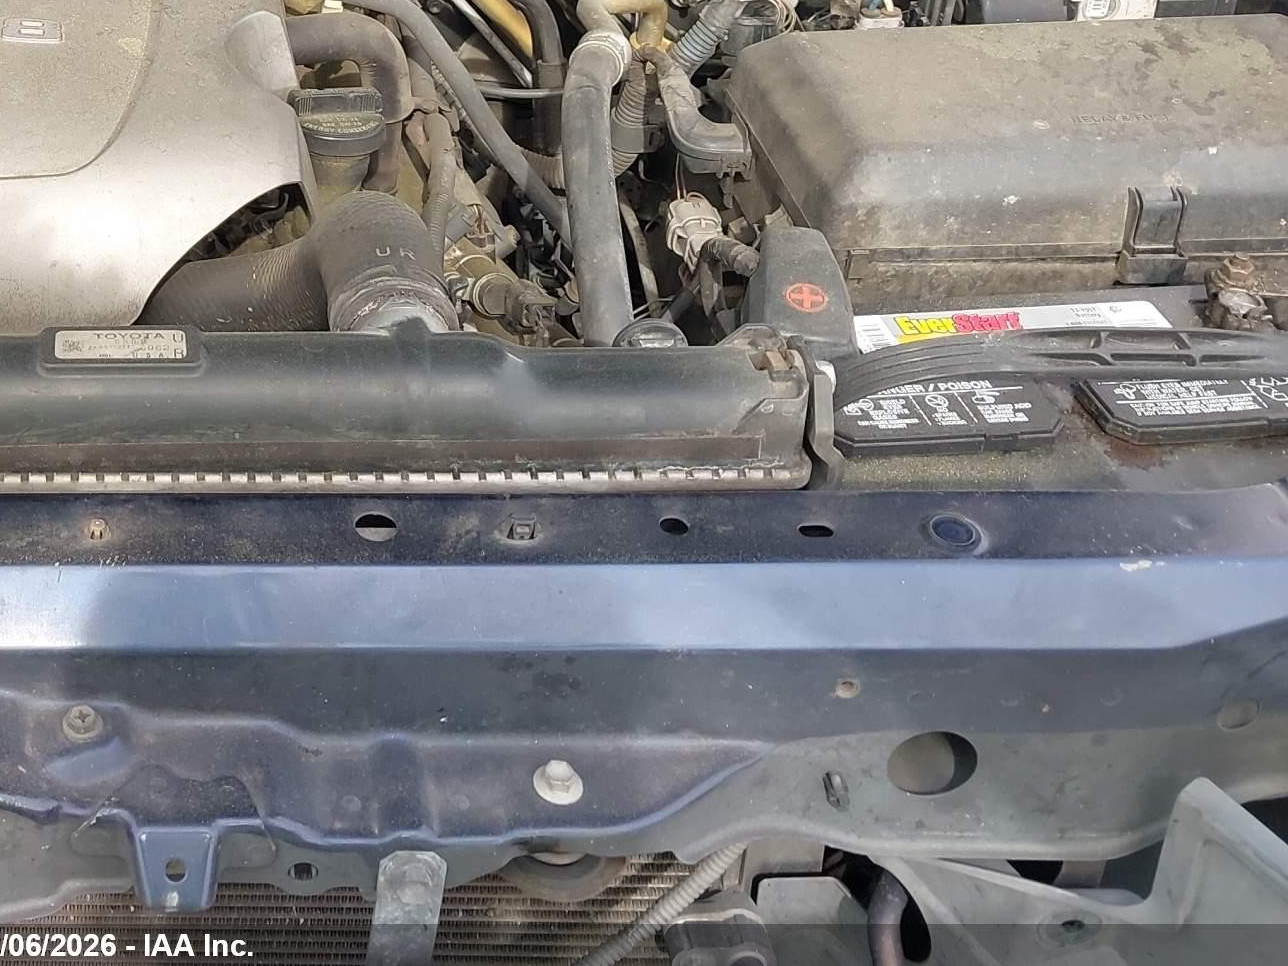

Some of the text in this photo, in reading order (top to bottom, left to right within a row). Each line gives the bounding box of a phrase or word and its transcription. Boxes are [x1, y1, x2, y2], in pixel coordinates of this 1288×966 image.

[893, 311, 1024, 336] EverStart
[95, 332, 165, 340] TOYOTA
[938, 380, 992, 391] POISON
